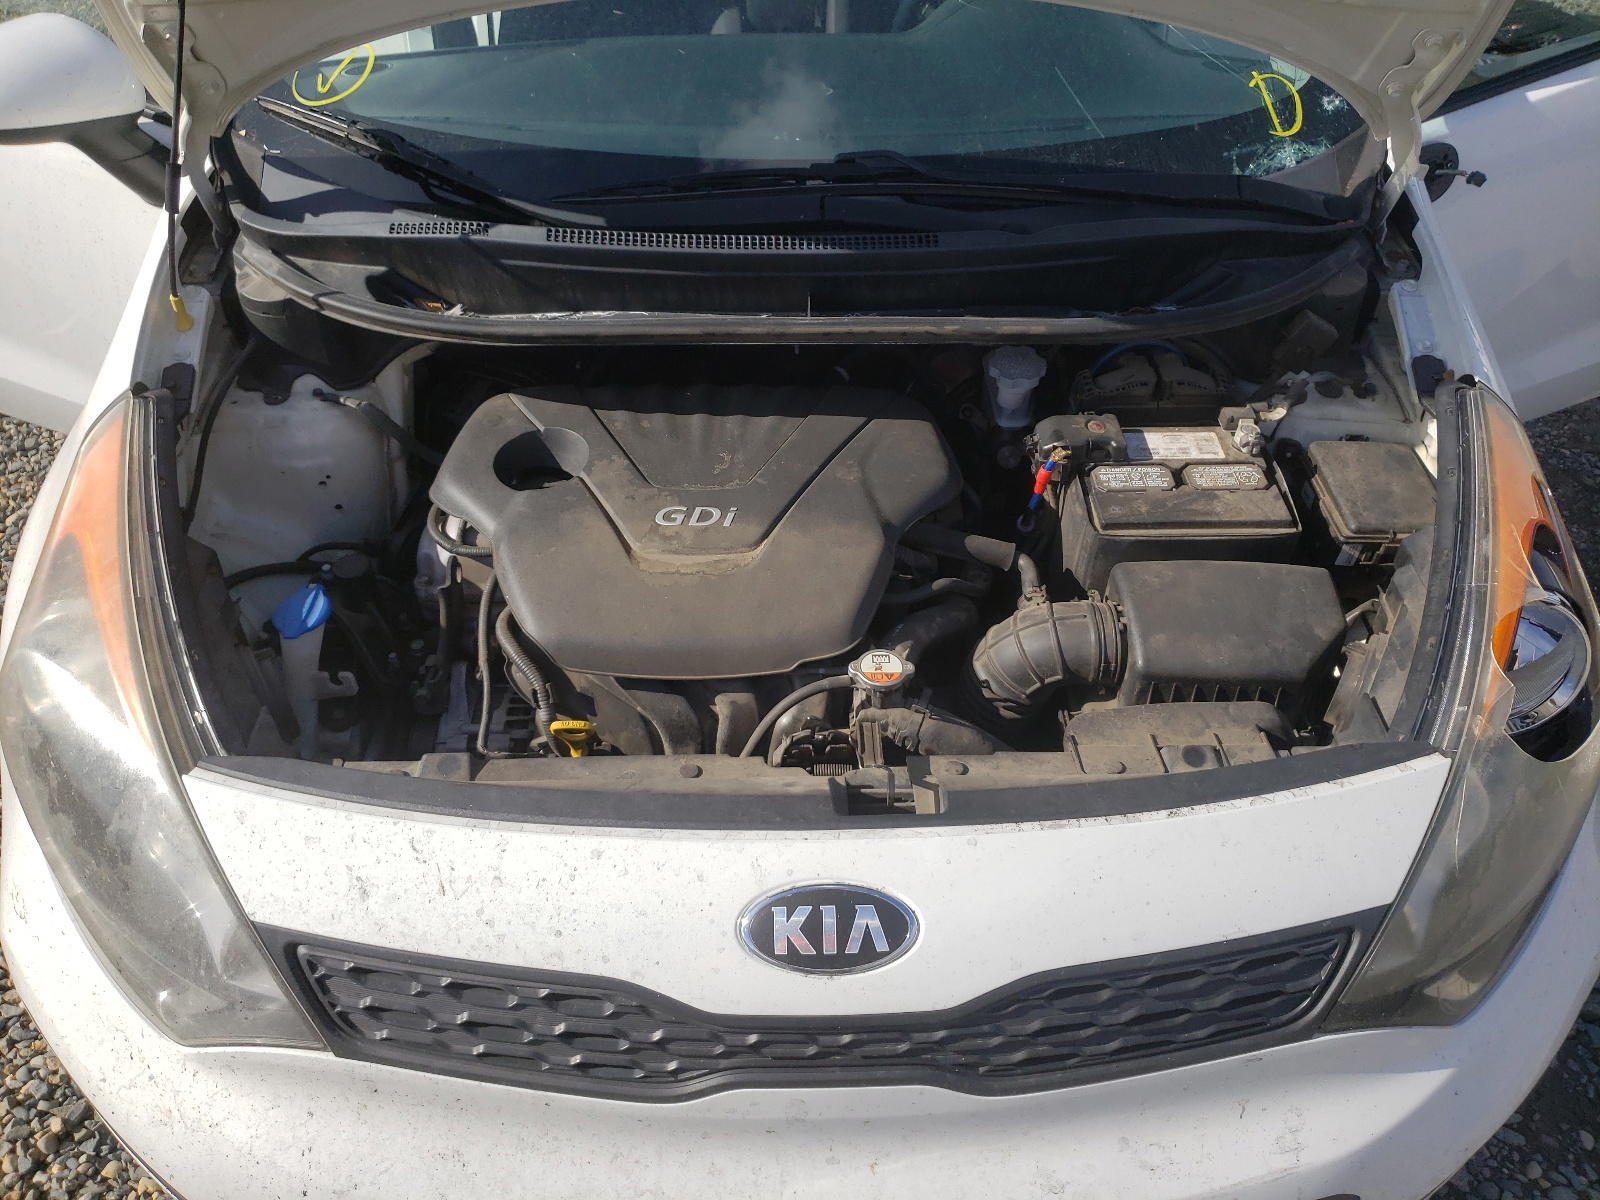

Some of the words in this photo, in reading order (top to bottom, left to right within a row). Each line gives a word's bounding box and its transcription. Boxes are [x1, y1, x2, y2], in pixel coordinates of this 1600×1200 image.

[1248, 71, 1303, 137] D
[655, 506, 739, 527] GDi
[771, 904, 890, 955] KIA
